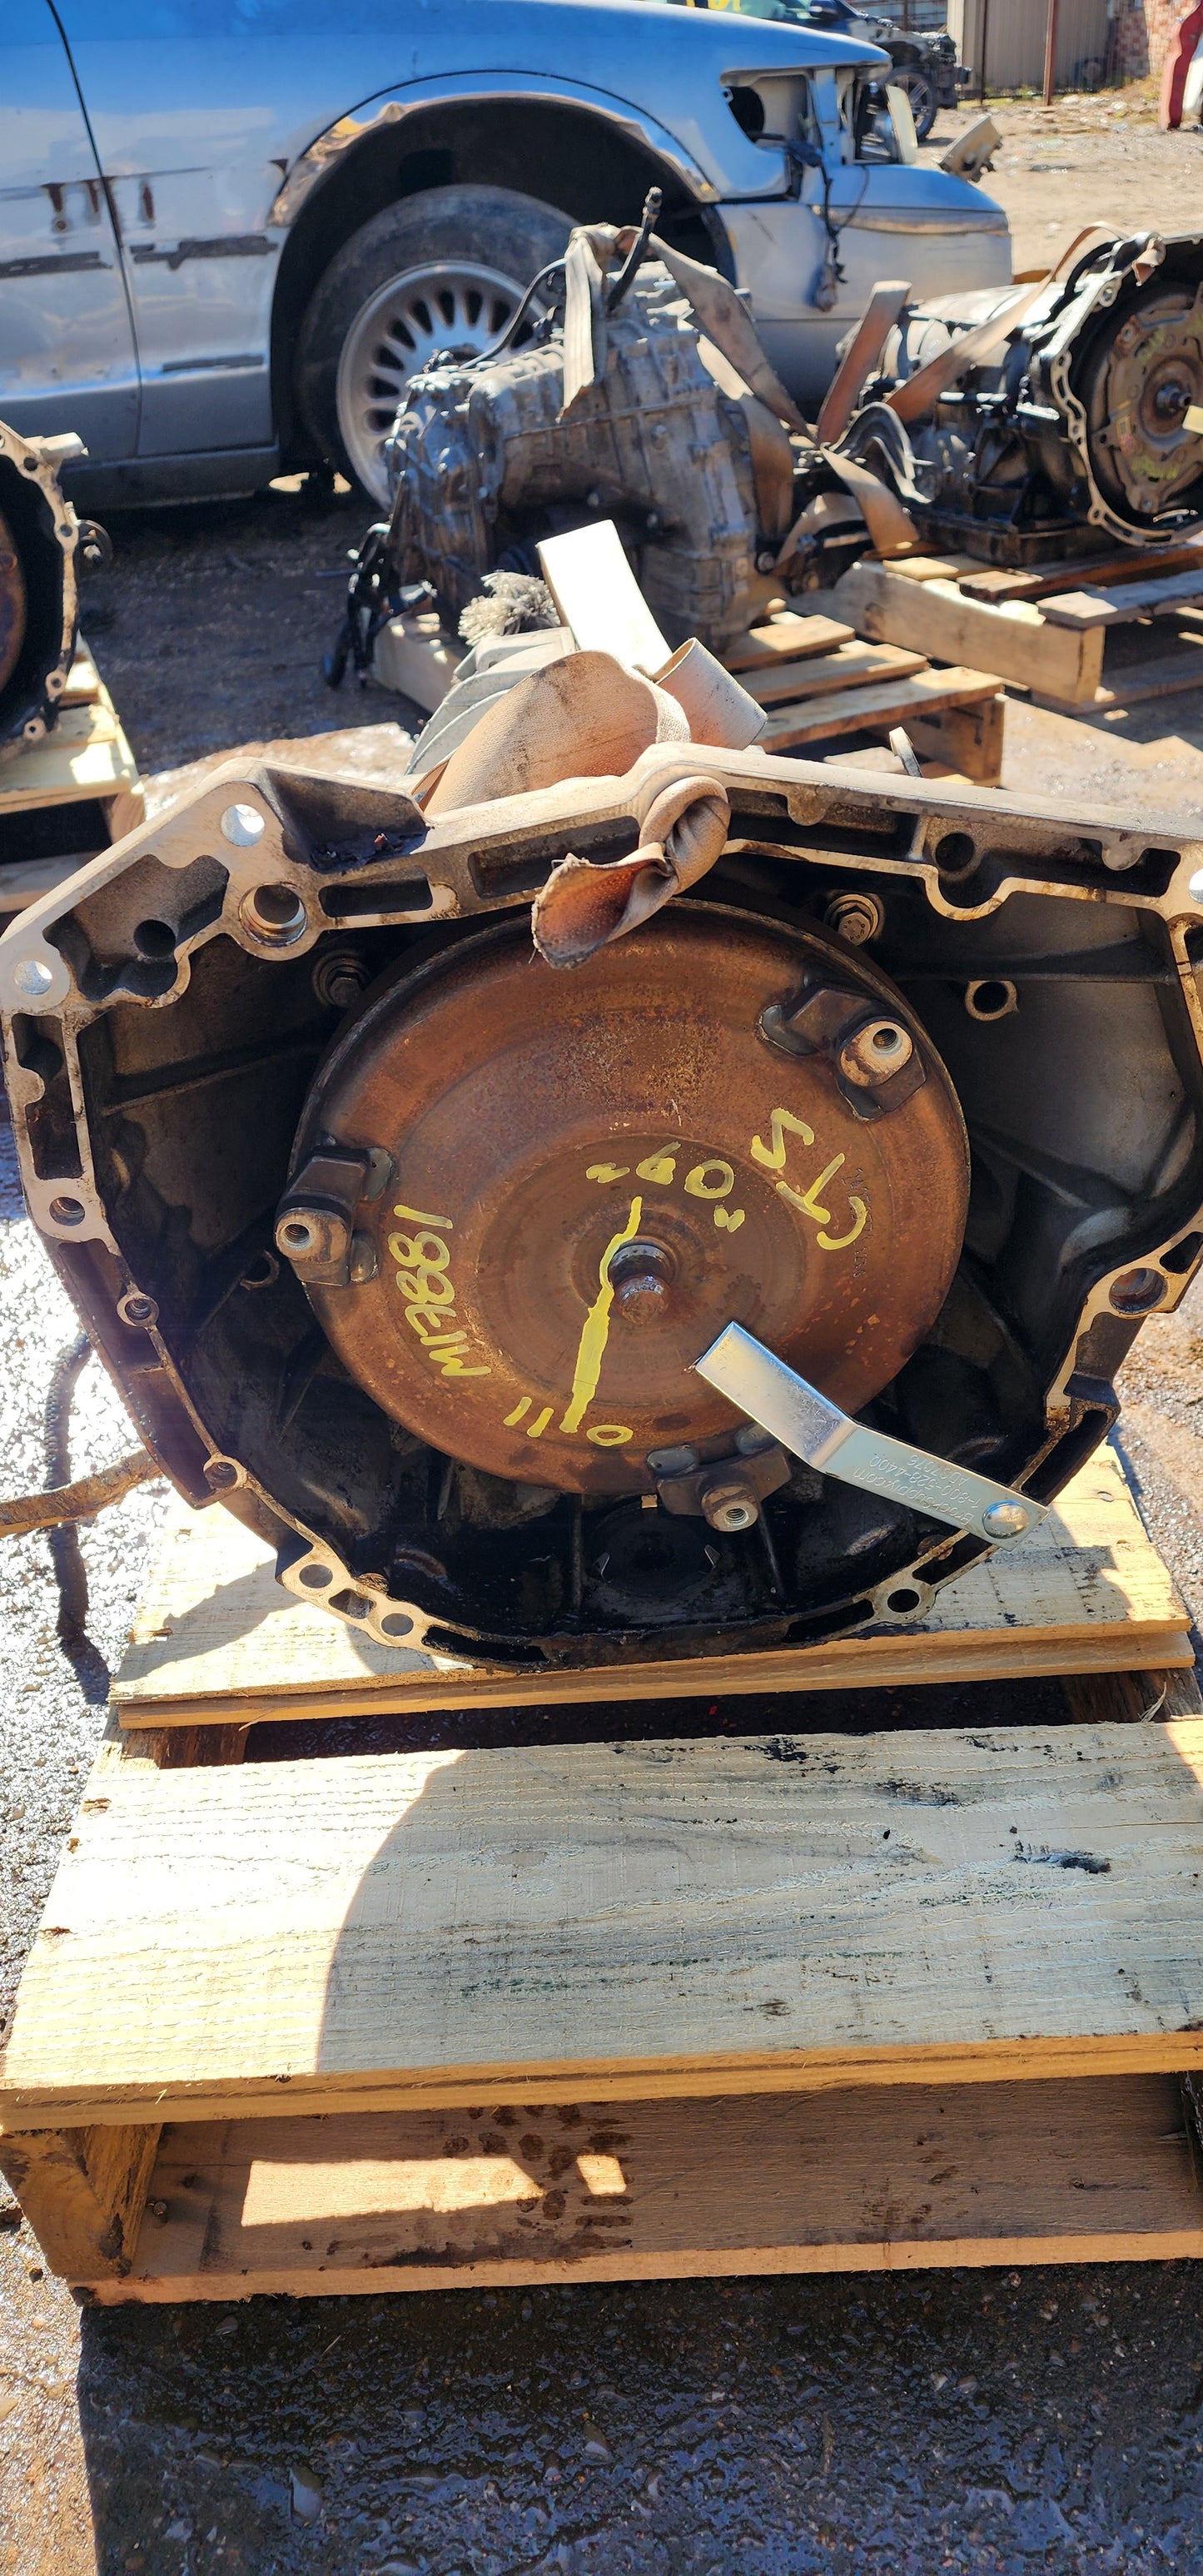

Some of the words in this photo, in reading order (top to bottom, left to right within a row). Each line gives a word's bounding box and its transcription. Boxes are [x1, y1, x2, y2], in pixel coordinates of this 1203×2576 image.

[751, 1107, 867, 1251] CTS
[388, 1204, 491, 1376] M17881
[853, 1466, 974, 1526] BrockSupply.com
[868, 1455, 982, 1509] 1-800-528-4400
